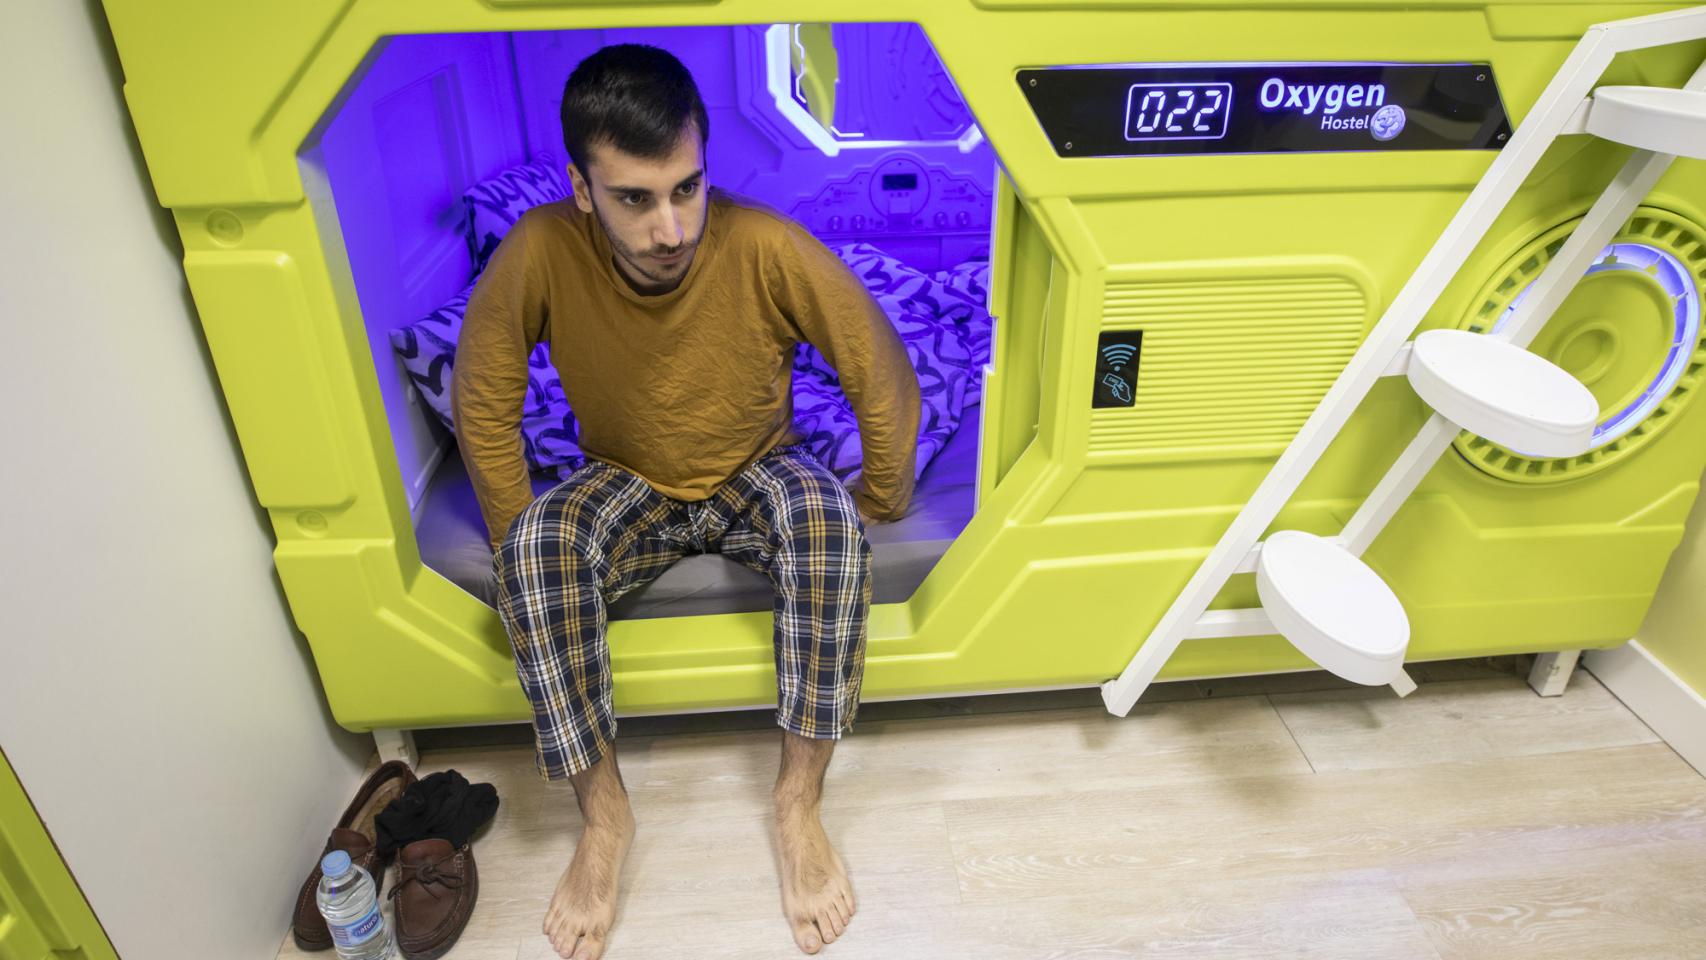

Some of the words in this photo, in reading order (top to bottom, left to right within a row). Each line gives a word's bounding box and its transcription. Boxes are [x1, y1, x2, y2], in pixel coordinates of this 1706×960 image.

[1136, 89, 1223, 133] 022
[1260, 78, 1385, 115] Oxygen
[1320, 114, 1370, 130] Hostel
